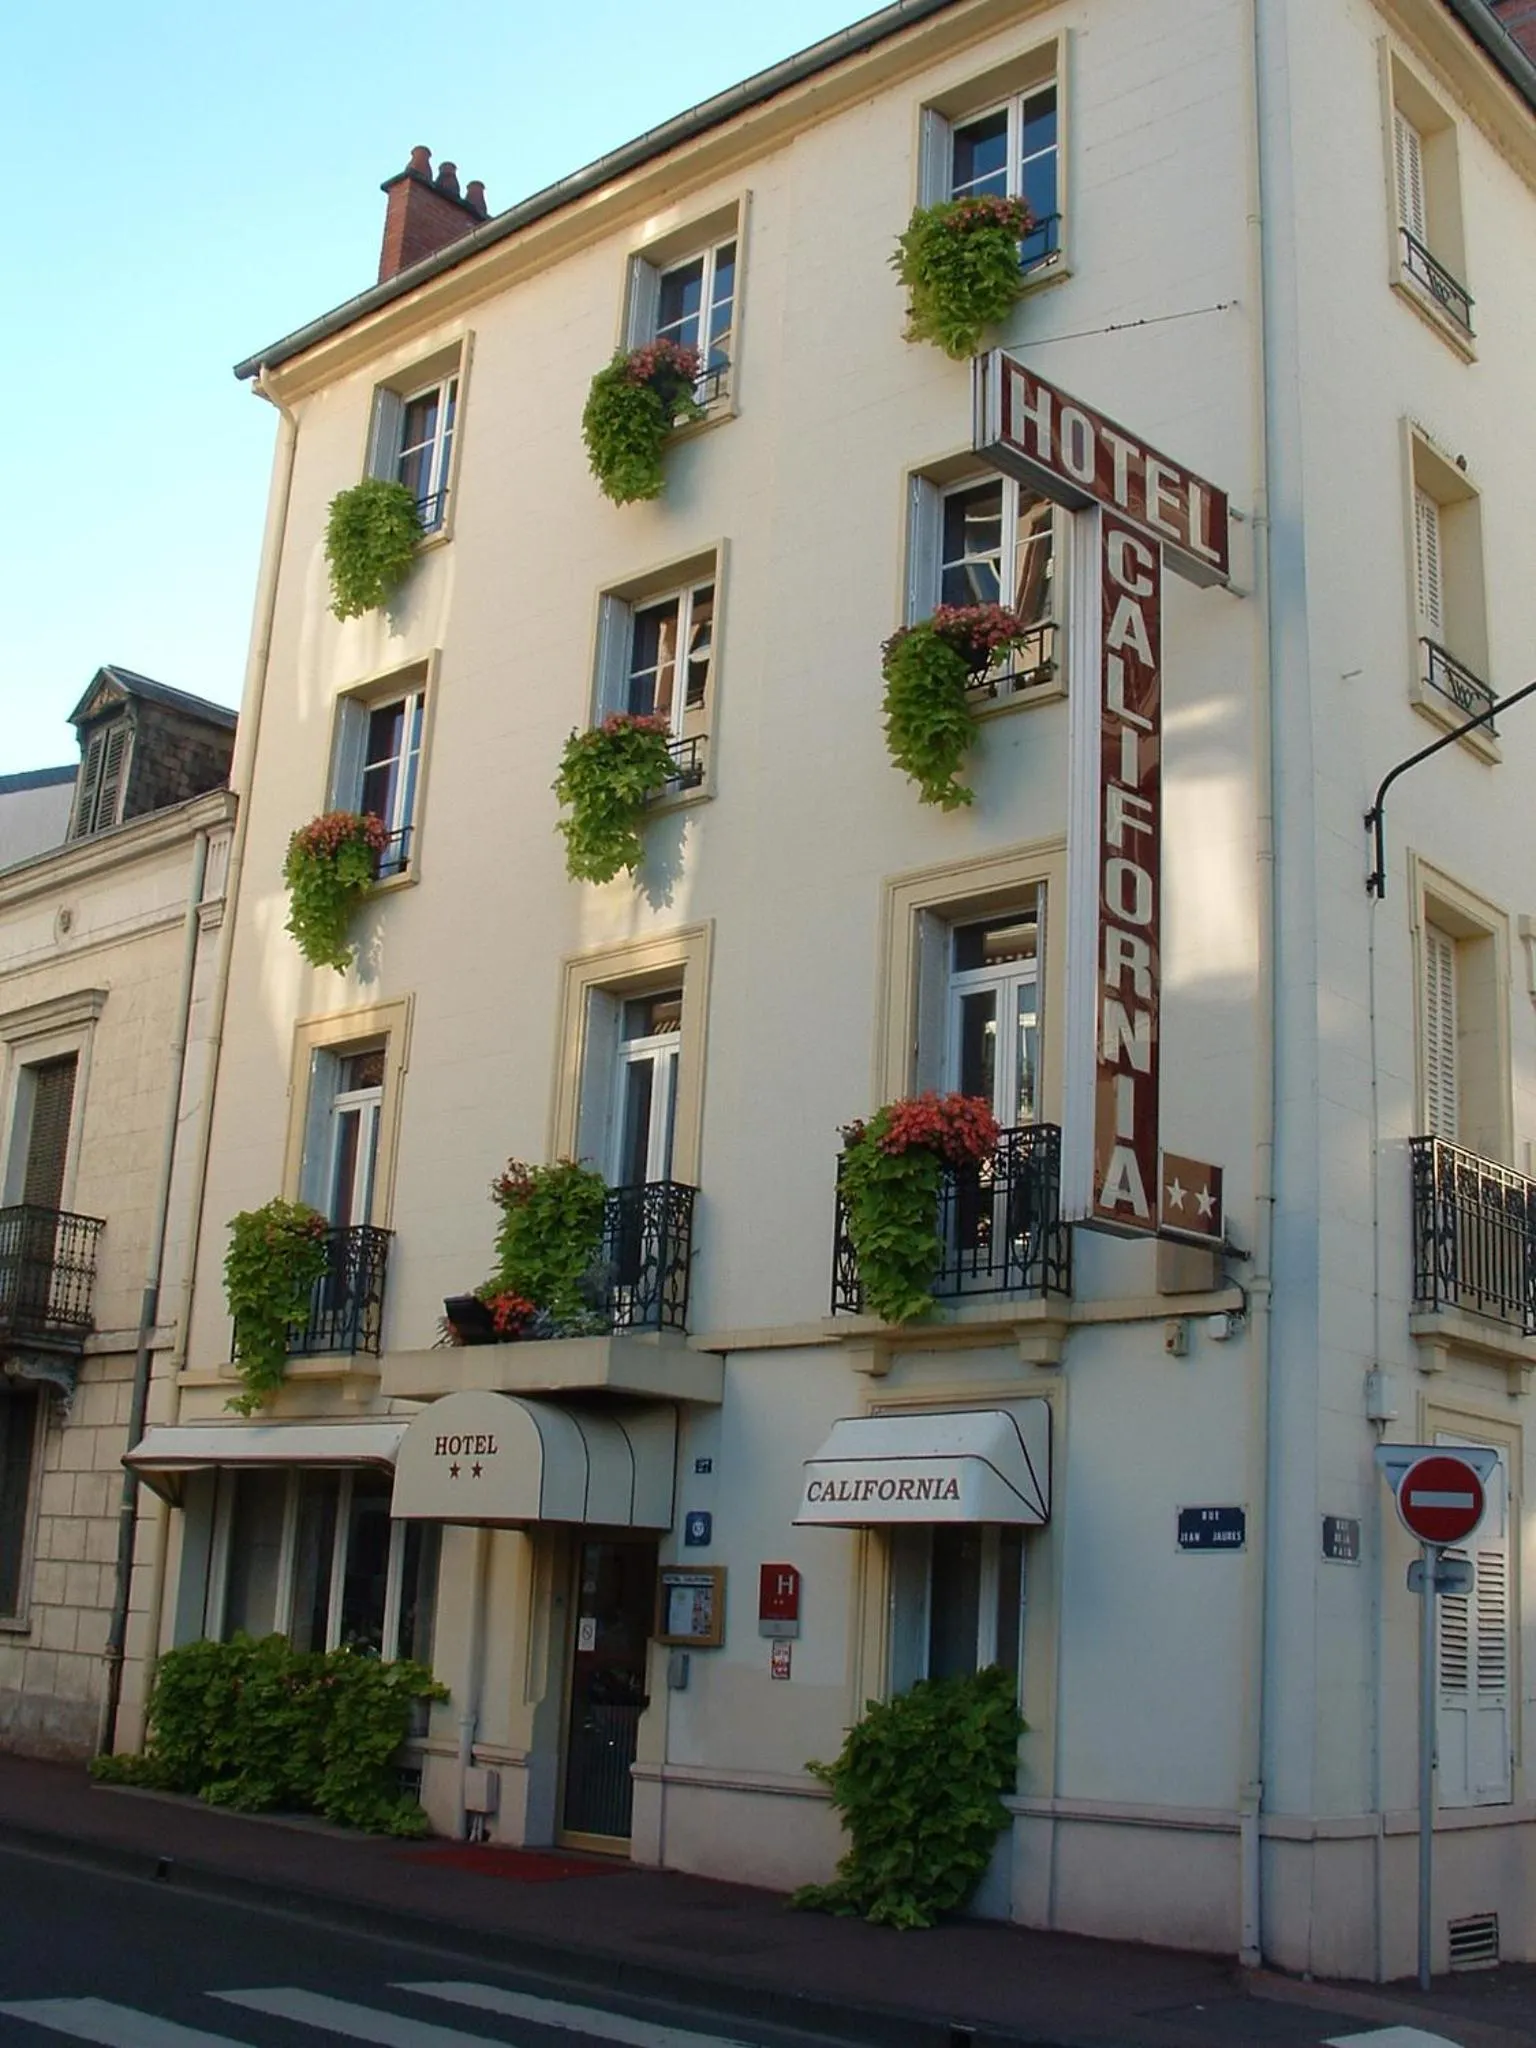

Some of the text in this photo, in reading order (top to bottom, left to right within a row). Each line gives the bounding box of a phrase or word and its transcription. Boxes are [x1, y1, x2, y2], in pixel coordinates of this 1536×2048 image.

[1010, 369, 1221, 564] HOTEL
[1100, 529, 1155, 1219] CALIFORNIA
[434, 1434, 498, 1456] HOTEL
[807, 1478, 961, 1502] CALIFORNIA
[1201, 1510, 1219, 1521] RUE
[1180, 1532, 1200, 1542] JEAN
[777, 1574, 794, 1595] H
